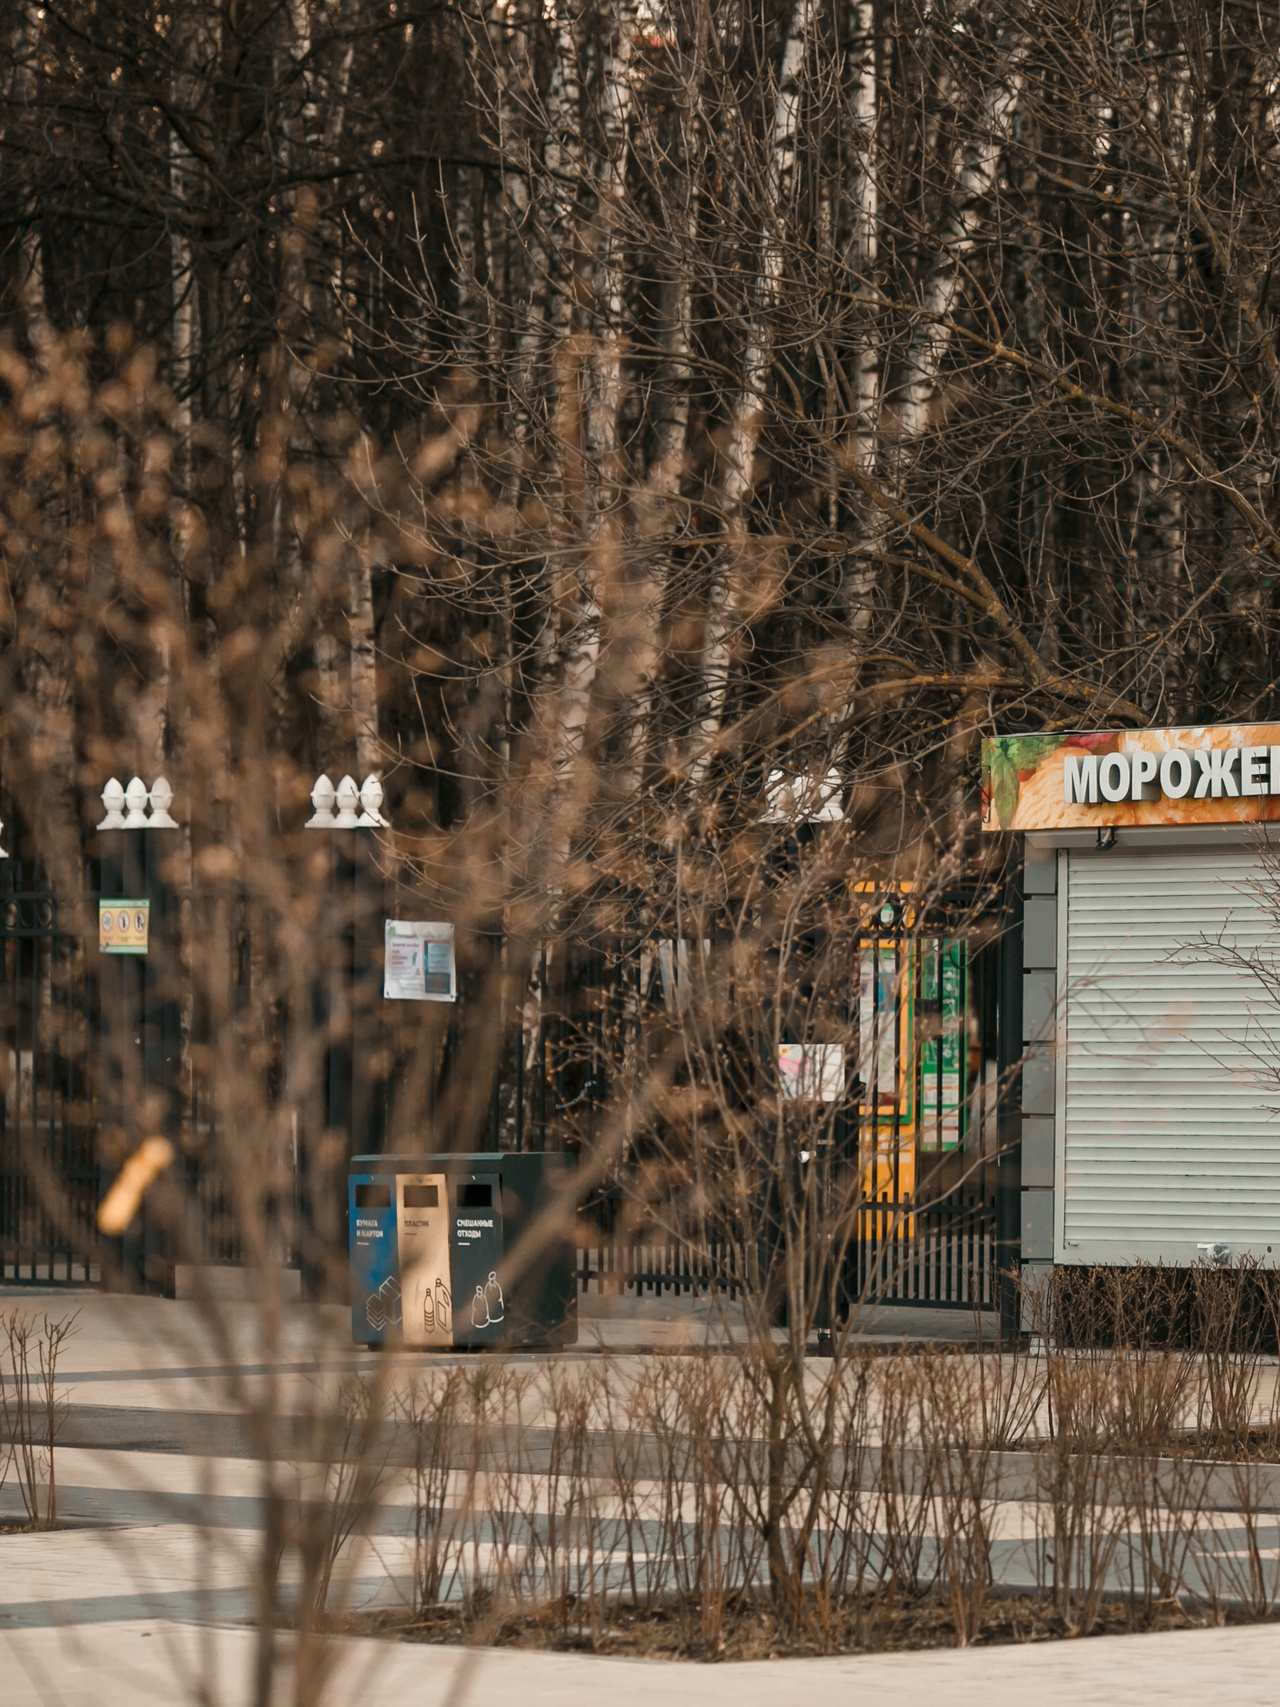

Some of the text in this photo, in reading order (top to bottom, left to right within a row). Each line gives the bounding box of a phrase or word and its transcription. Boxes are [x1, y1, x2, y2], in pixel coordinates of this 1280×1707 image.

[356, 1219, 378, 1227] БУМАГА
[404, 1220, 430, 1228] ПЛАСТИК
[456, 1219, 494, 1228] СМЕШАННЫЕ
[362, 1230, 384, 1238] КАРТОН
[456, 1229, 481, 1239] ОТХОДЫ
